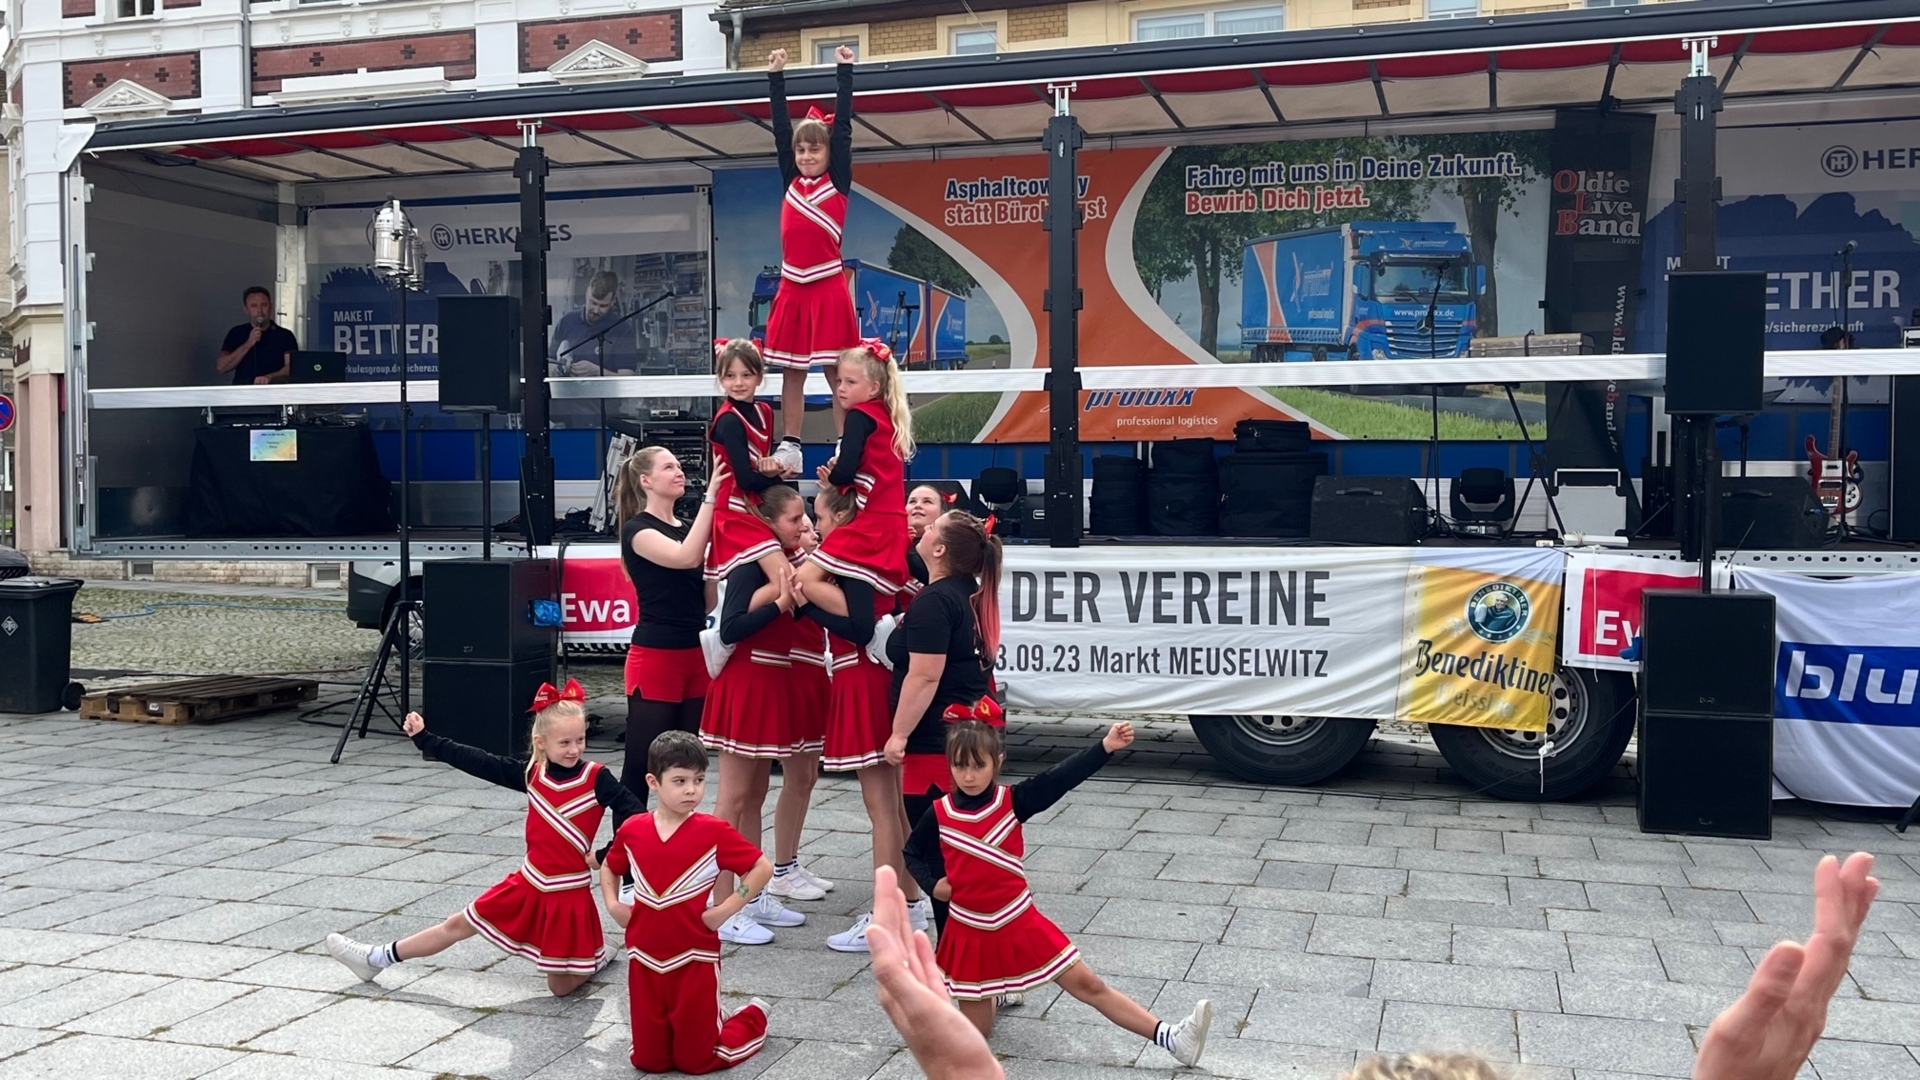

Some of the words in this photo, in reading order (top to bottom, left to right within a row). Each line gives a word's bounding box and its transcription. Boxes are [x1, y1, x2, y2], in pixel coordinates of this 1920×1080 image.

[1187, 164, 1245, 188] Fahre
[1251, 162, 1284, 185] mit
[1291, 165, 1328, 184] uns
[1334, 159, 1355, 181] in
[1361, 156, 1422, 180] Deine
[1428, 152, 1522, 178] Zukunft.
[1554, 170, 1630, 193] Oldie
[945, 176, 1090, 203] Asphaltcowy
[1186, 189, 1257, 215] Bewirb
[1264, 187, 1311, 213] Dich
[1314, 186, 1370, 214] jetzt.
[1574, 191, 1632, 215] Live
[945, 204, 991, 226] statt
[995, 197, 1107, 225] Bürohst
[1555, 209, 1640, 236] Band
[455, 224, 572, 245] HERKES
[1766, 270, 1901, 309] ETHER
[334, 311, 362, 322] MAKE
[364, 310, 373, 321] IT
[1394, 309, 1454, 318] www.proxx.de
[334, 324, 438, 355] BETTER
[1116, 416, 1174, 428] professional
[1178, 416, 1218, 428] logistics
[561, 593, 630, 622] Ewa
[1011, 571, 1101, 623] DER
[1118, 571, 1330, 626] VEREINE
[1090, 645, 1161, 675] Markt
[1168, 646, 1328, 677] MEUSELWITZ
[1785, 650, 1919, 704] blu
